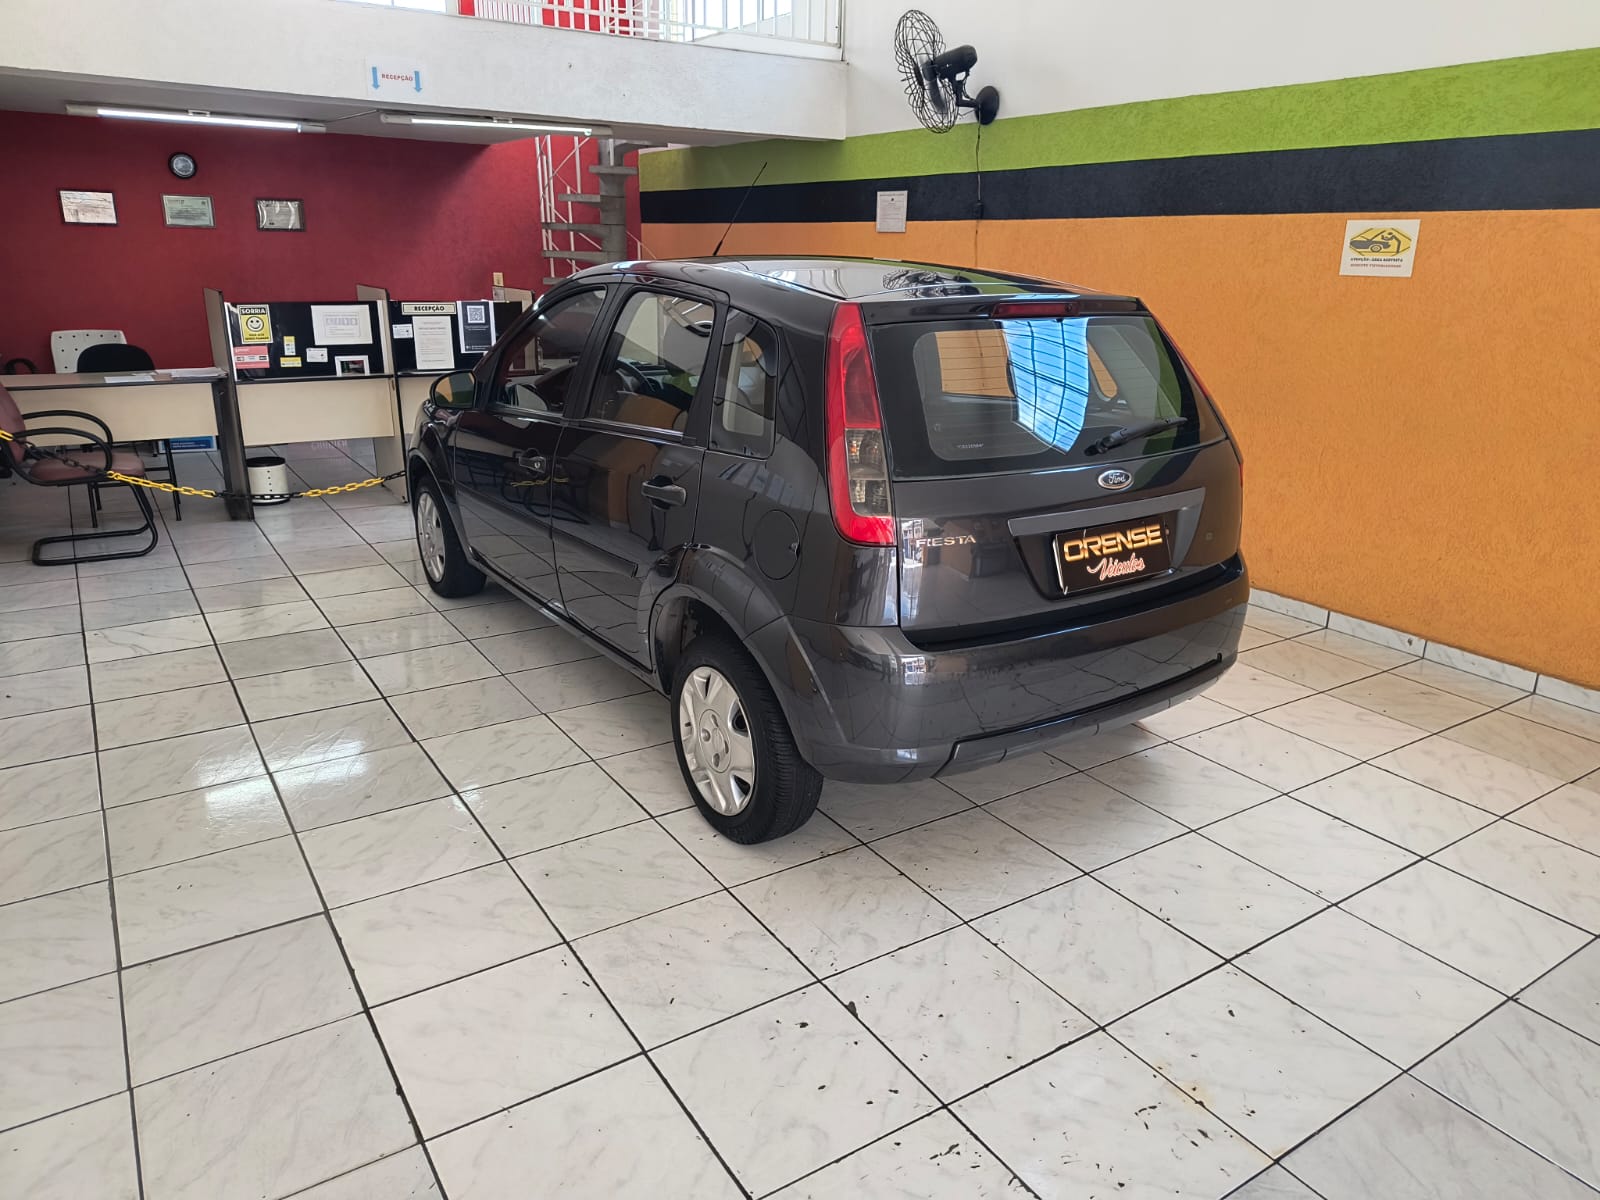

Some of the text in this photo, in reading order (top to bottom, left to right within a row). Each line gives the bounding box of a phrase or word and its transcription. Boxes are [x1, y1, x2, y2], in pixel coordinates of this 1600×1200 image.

[381, 73, 414, 81] RECEPÇÃO
[414, 305, 445, 313] RECEPÇÃO
[916, 534, 977, 548] FIESTA
[1063, 523, 1162, 562] ORENSE
